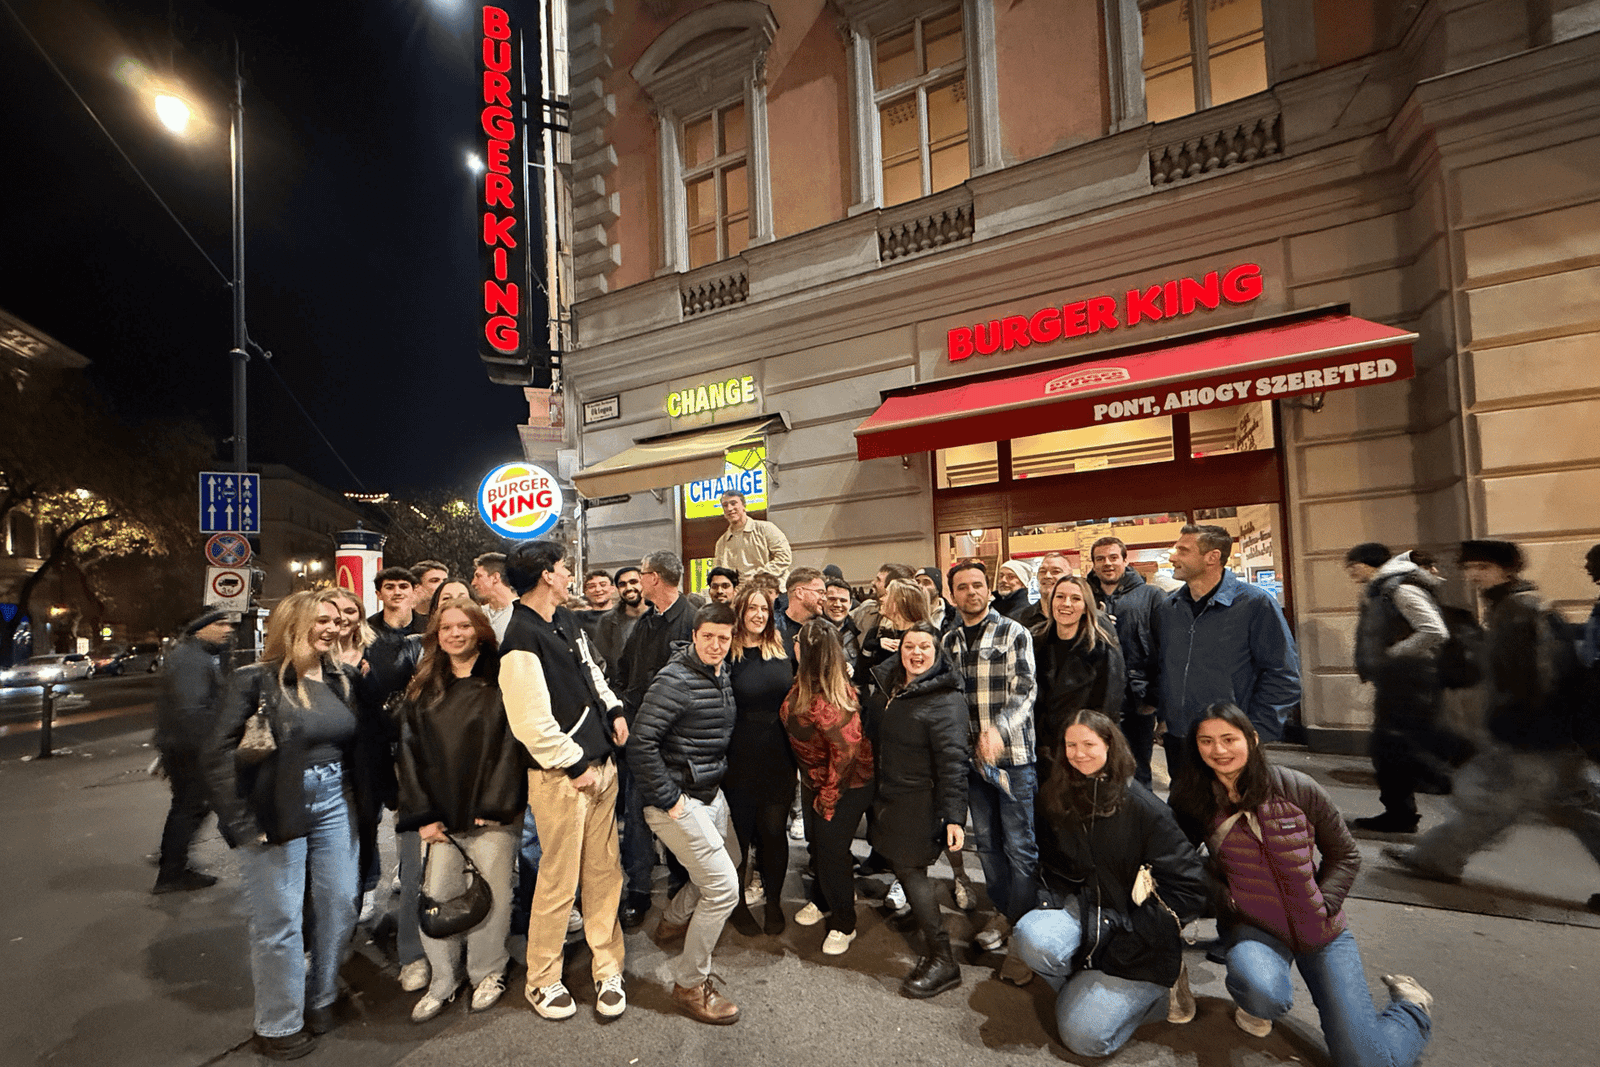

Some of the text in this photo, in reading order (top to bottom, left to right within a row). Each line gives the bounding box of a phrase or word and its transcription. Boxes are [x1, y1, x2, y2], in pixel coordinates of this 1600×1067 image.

[481, 5, 519, 353] BURGER KING
[948, 263, 1263, 362] BURGER KING
[667, 376, 755, 417] CHANGE
[1093, 396, 1161, 421] PONT,
[1163, 380, 1252, 411] AHOGY
[1256, 358, 1397, 397] SZERETED
[488, 477, 549, 503] BURGER
[491, 490, 552, 522] KING
[690, 470, 763, 502] CHANGE
